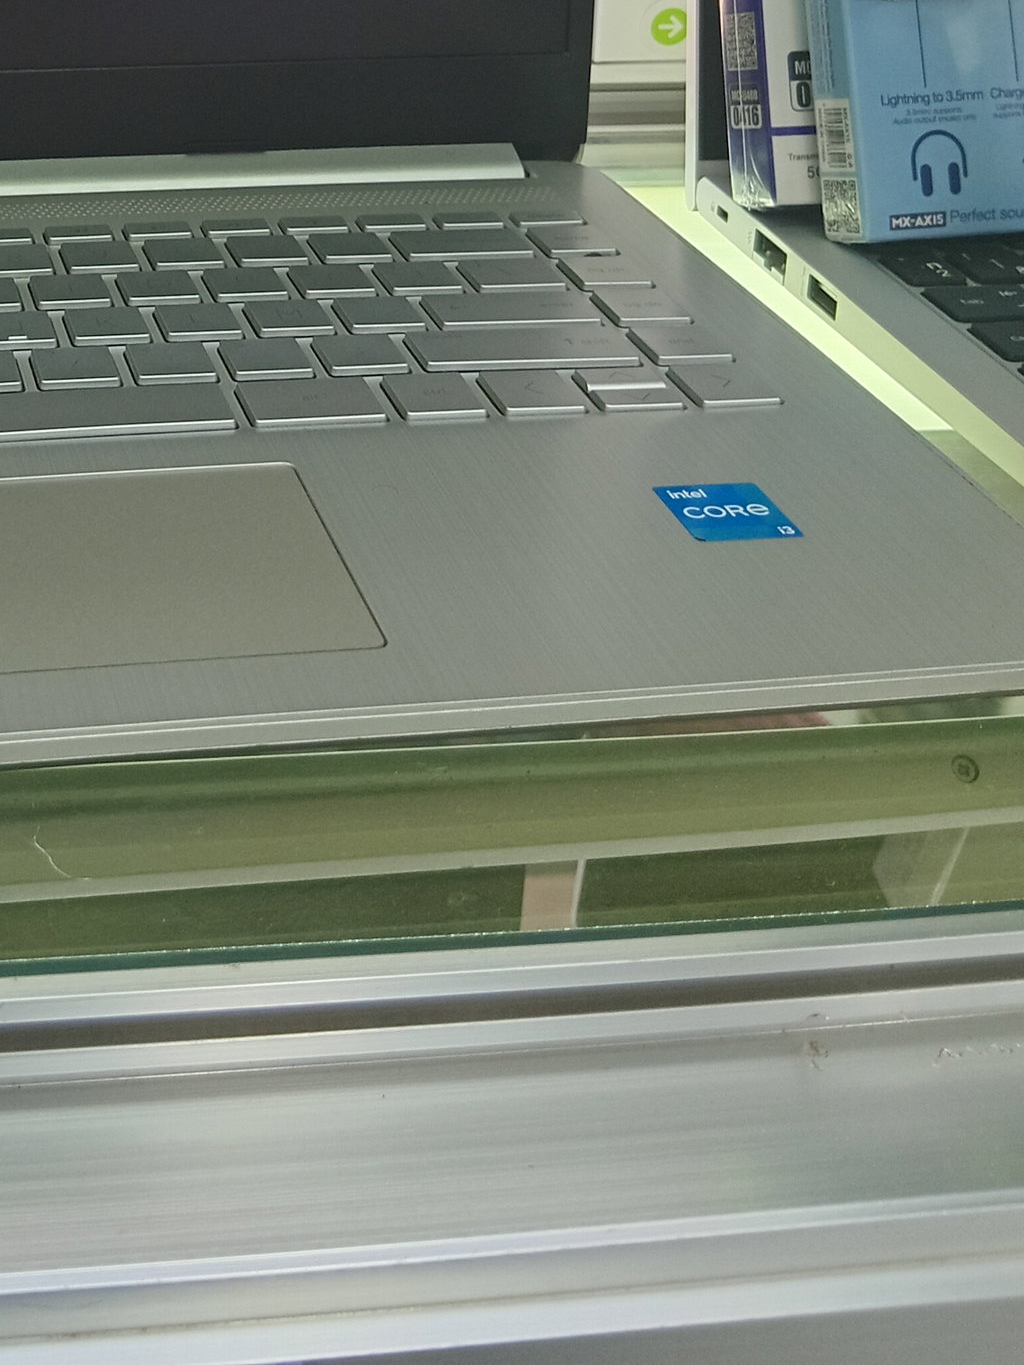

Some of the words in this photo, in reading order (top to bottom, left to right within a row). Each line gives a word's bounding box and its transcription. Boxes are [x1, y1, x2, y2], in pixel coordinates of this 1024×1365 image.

[880, 93, 931, 109] Lightning
[932, 91, 944, 103] to
[945, 89, 984, 102] 3.5mm
[950, 208, 995, 223] Perfect
[776, 525, 796, 535] i3
